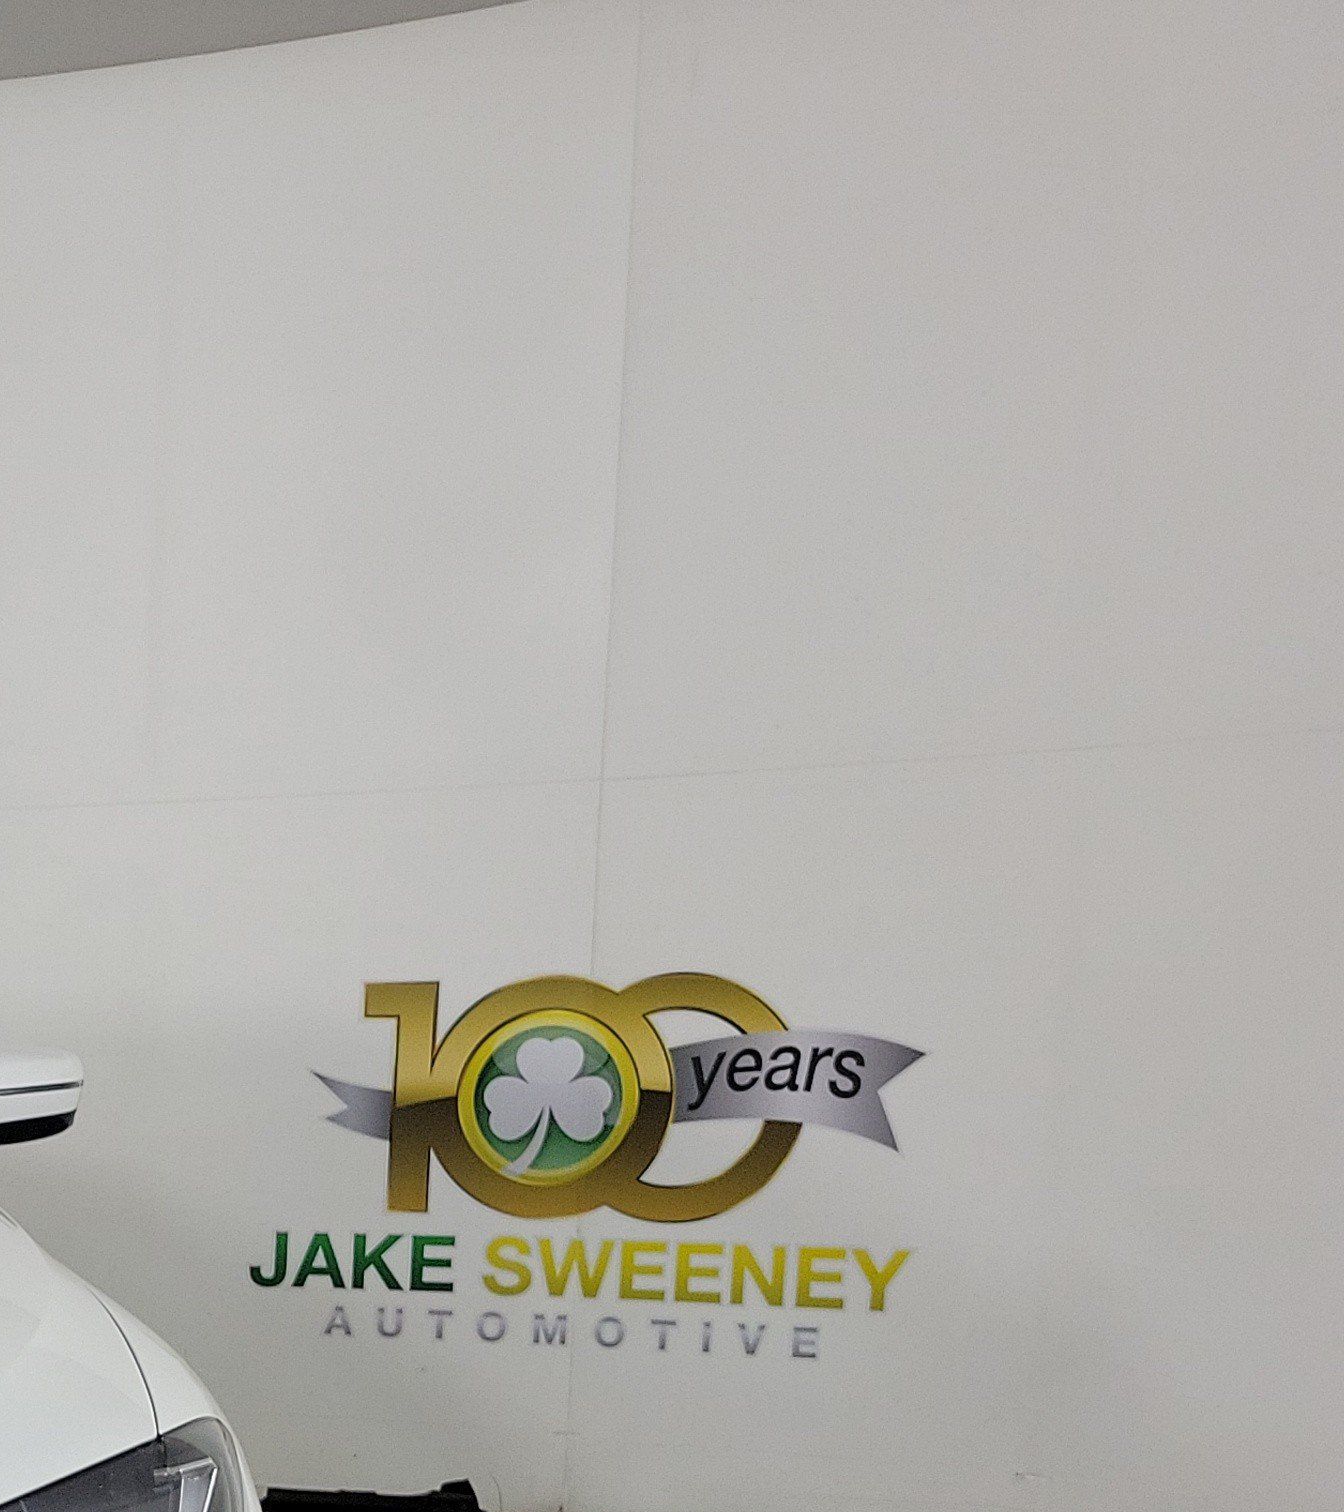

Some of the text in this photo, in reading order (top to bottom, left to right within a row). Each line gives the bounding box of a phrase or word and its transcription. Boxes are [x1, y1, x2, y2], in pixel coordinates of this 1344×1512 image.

[364, 971, 866, 1222] 100 years
[248, 1230, 910, 1313] JAKE SWEENEY
[322, 1305, 819, 1359] AUTOMOTIVE
